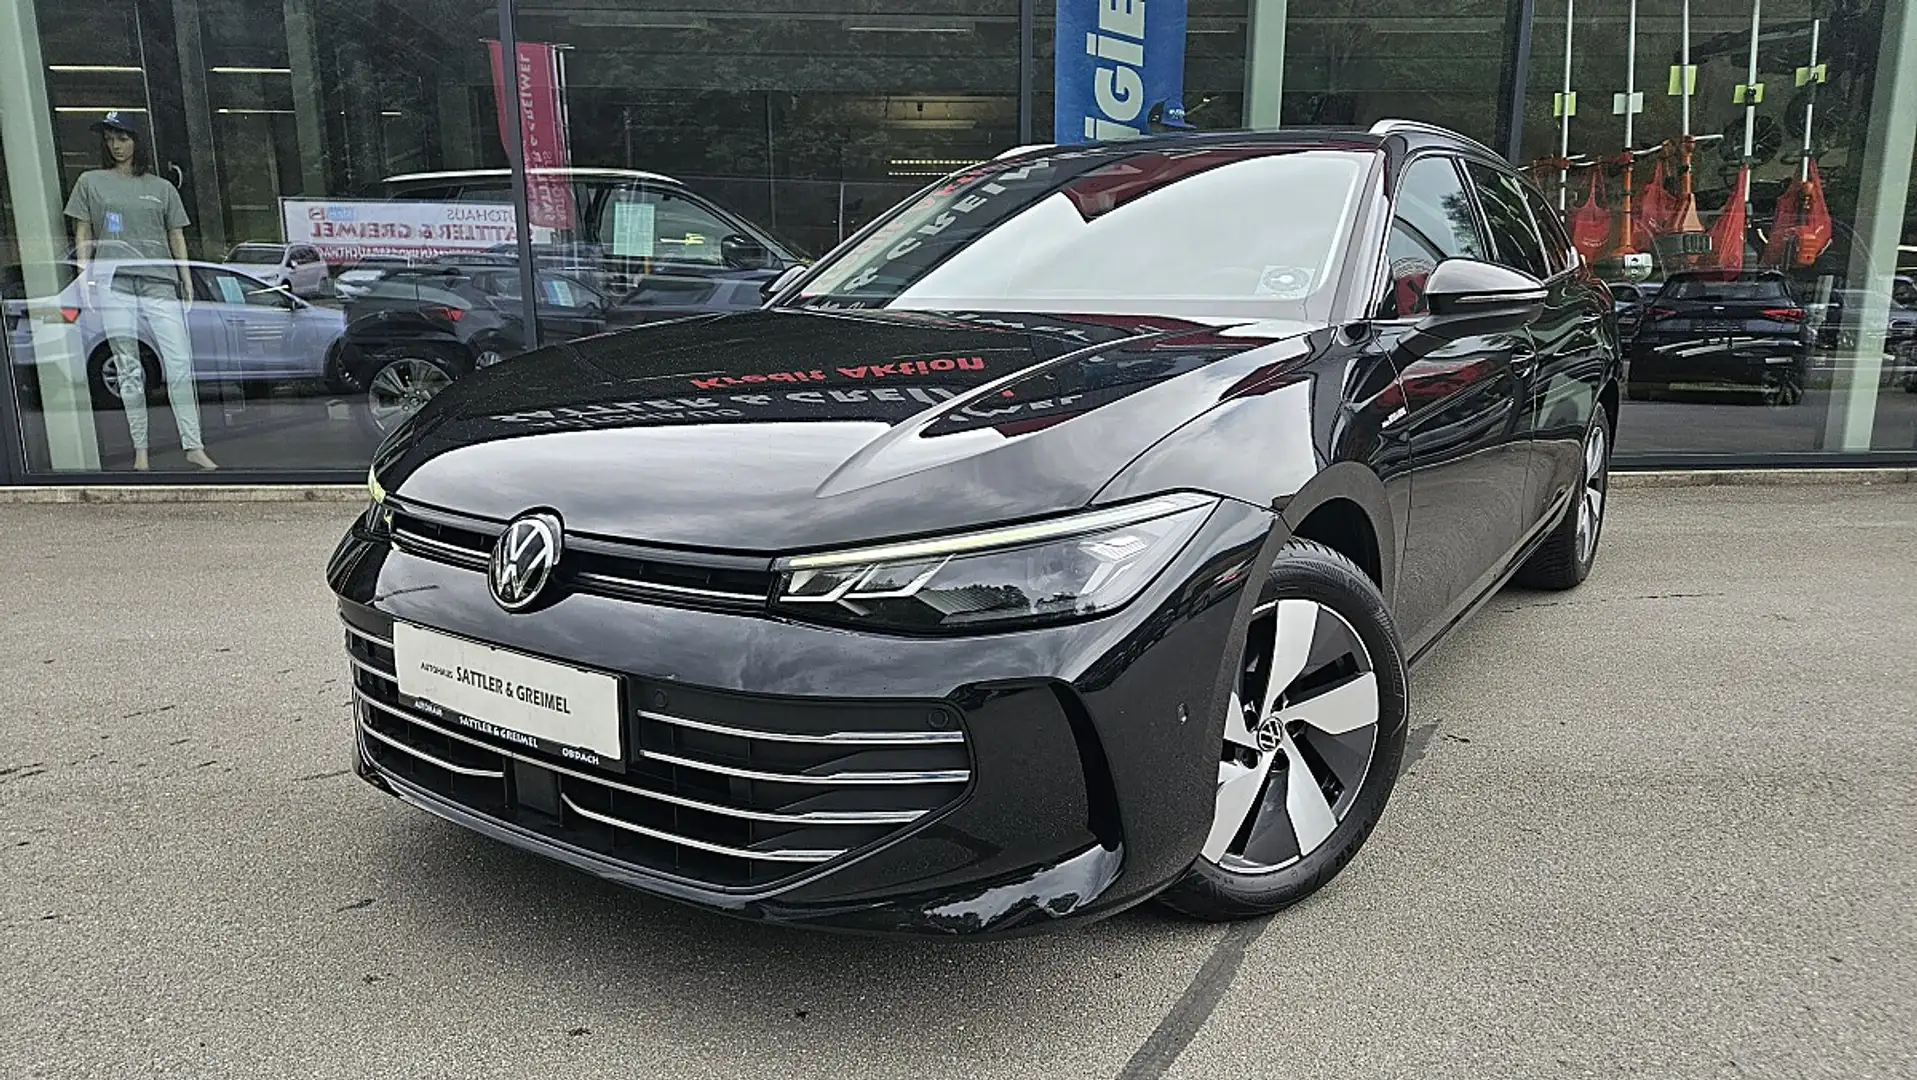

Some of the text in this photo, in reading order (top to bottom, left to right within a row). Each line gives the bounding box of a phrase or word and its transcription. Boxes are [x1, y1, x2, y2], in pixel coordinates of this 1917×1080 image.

[456, 665, 503, 695] SATTLER
[505, 681, 515, 698] &
[515, 684, 571, 715] GREIMEL
[459, 715, 493, 735] SATTLER
[500, 729, 539, 749] GREIMEL
[562, 747, 600, 766] OBDACH
